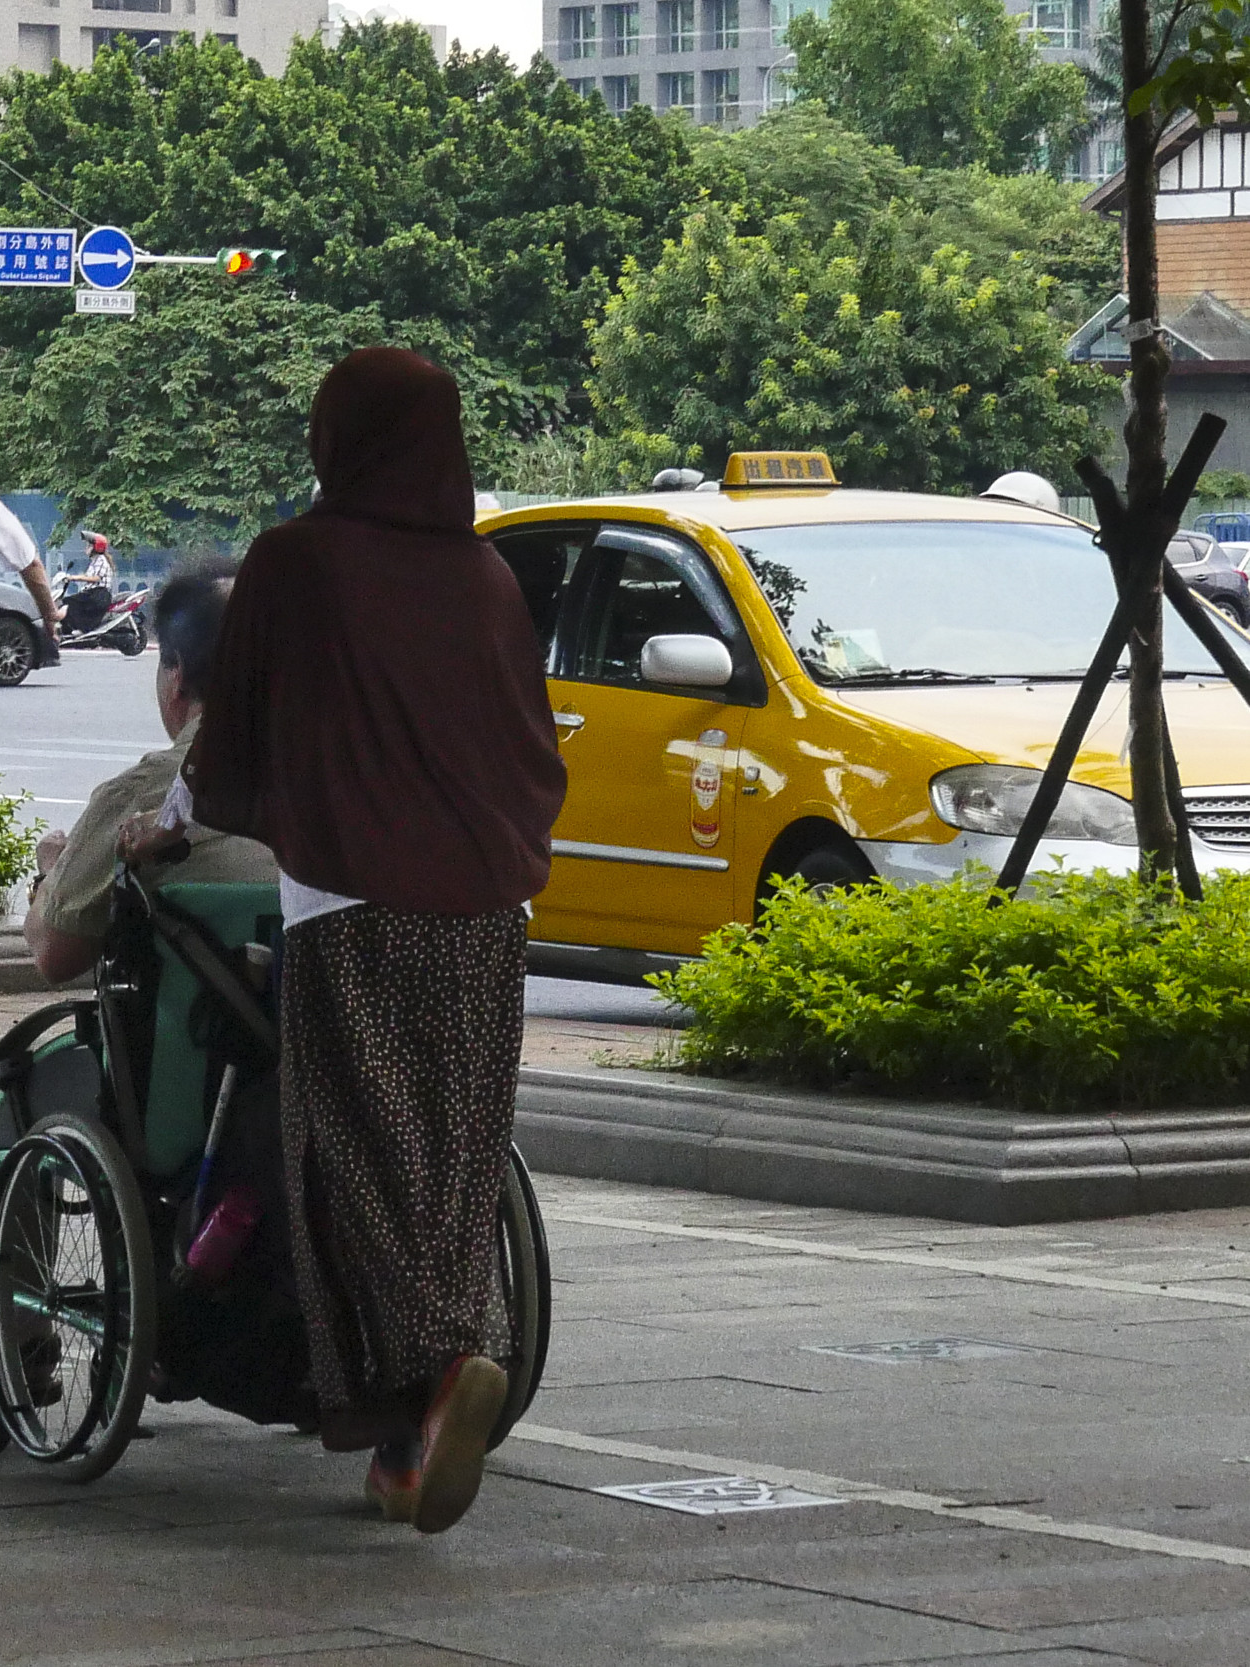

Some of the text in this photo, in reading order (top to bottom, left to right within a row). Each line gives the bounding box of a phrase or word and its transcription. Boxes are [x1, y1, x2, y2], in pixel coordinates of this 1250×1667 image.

[38, 273, 60, 281] Signal
[83, 296, 128, 307] 劃分島外側
